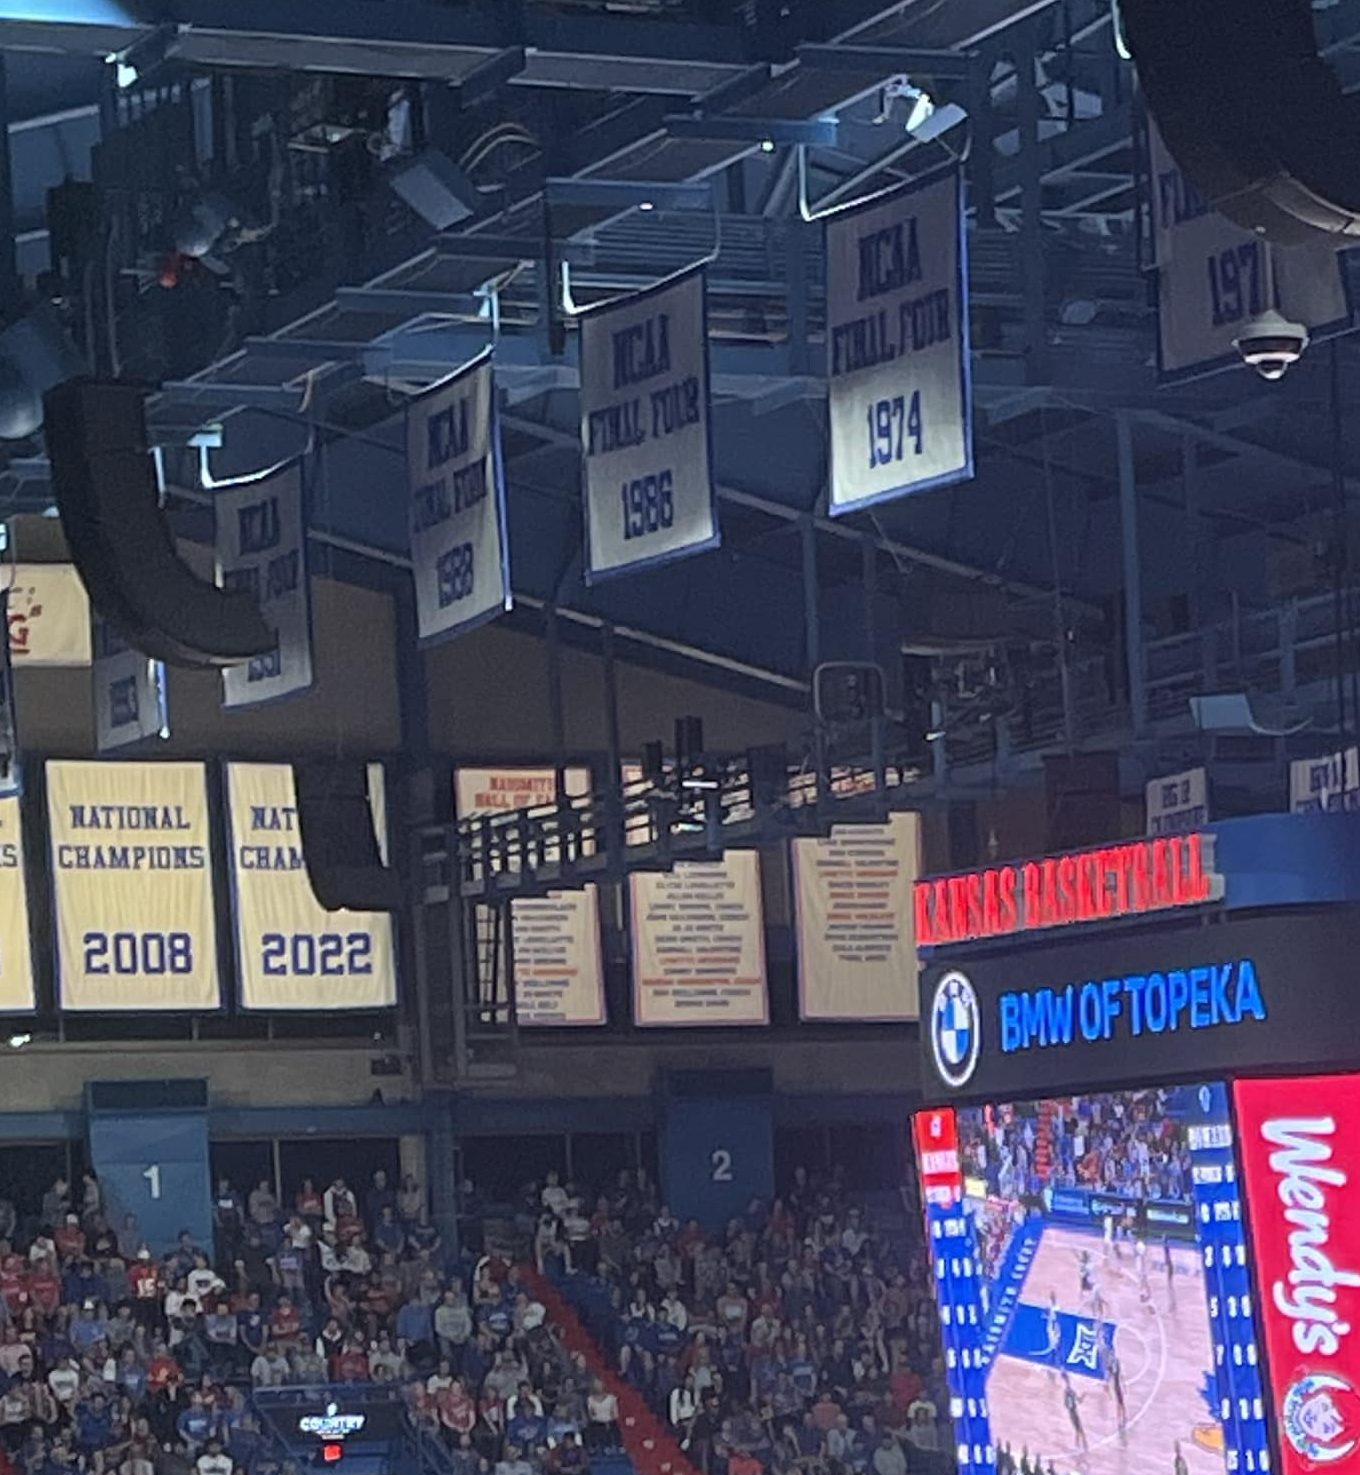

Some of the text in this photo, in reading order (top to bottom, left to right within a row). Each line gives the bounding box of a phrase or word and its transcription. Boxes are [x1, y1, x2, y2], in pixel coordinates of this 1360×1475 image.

[859, 217, 922, 301] NCAA
[1207, 241, 1276, 327] 197
[612, 314, 671, 390] NCAA
[832, 288, 952, 377] FINAL FOUR
[649, 377, 700, 440] FOUR
[867, 391, 924, 468] 1974
[621, 469, 675, 540] 1986
[70, 805, 191, 830] NATIONAL
[58, 845, 205, 869] CHAMPIONS
[914, 866, 1018, 946] KANSAS
[1023, 832, 1212, 928] BASKETBALL
[83, 933, 193, 975] 2008
[261, 933, 373, 975] 2022
[1001, 959, 1267, 1053] BMW OF TOPEKA
[142, 1163, 163, 1199] 1
[711, 1149, 734, 1181] 2
